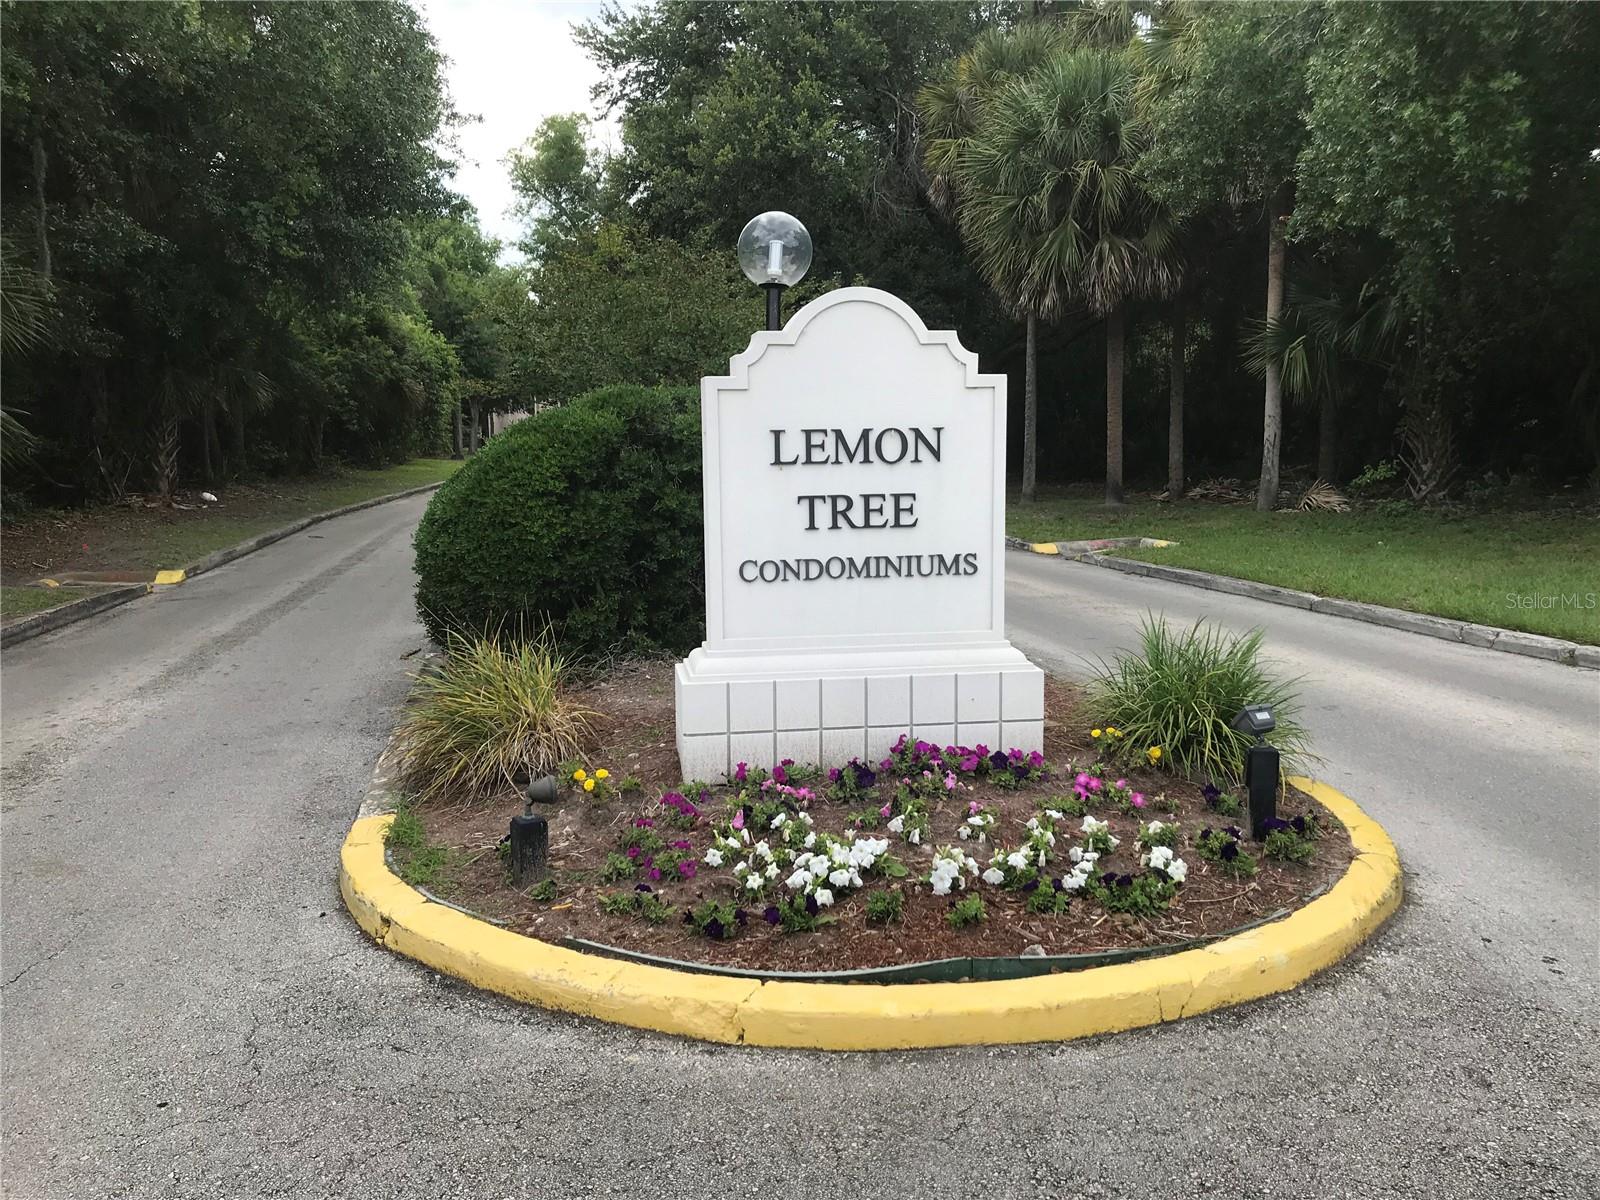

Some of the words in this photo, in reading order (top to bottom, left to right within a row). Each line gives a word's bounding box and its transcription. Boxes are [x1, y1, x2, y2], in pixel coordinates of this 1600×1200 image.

[770, 427, 944, 466] LEMON
[797, 493, 919, 531] TREE
[739, 553, 979, 583] CONDOMINIUMS
